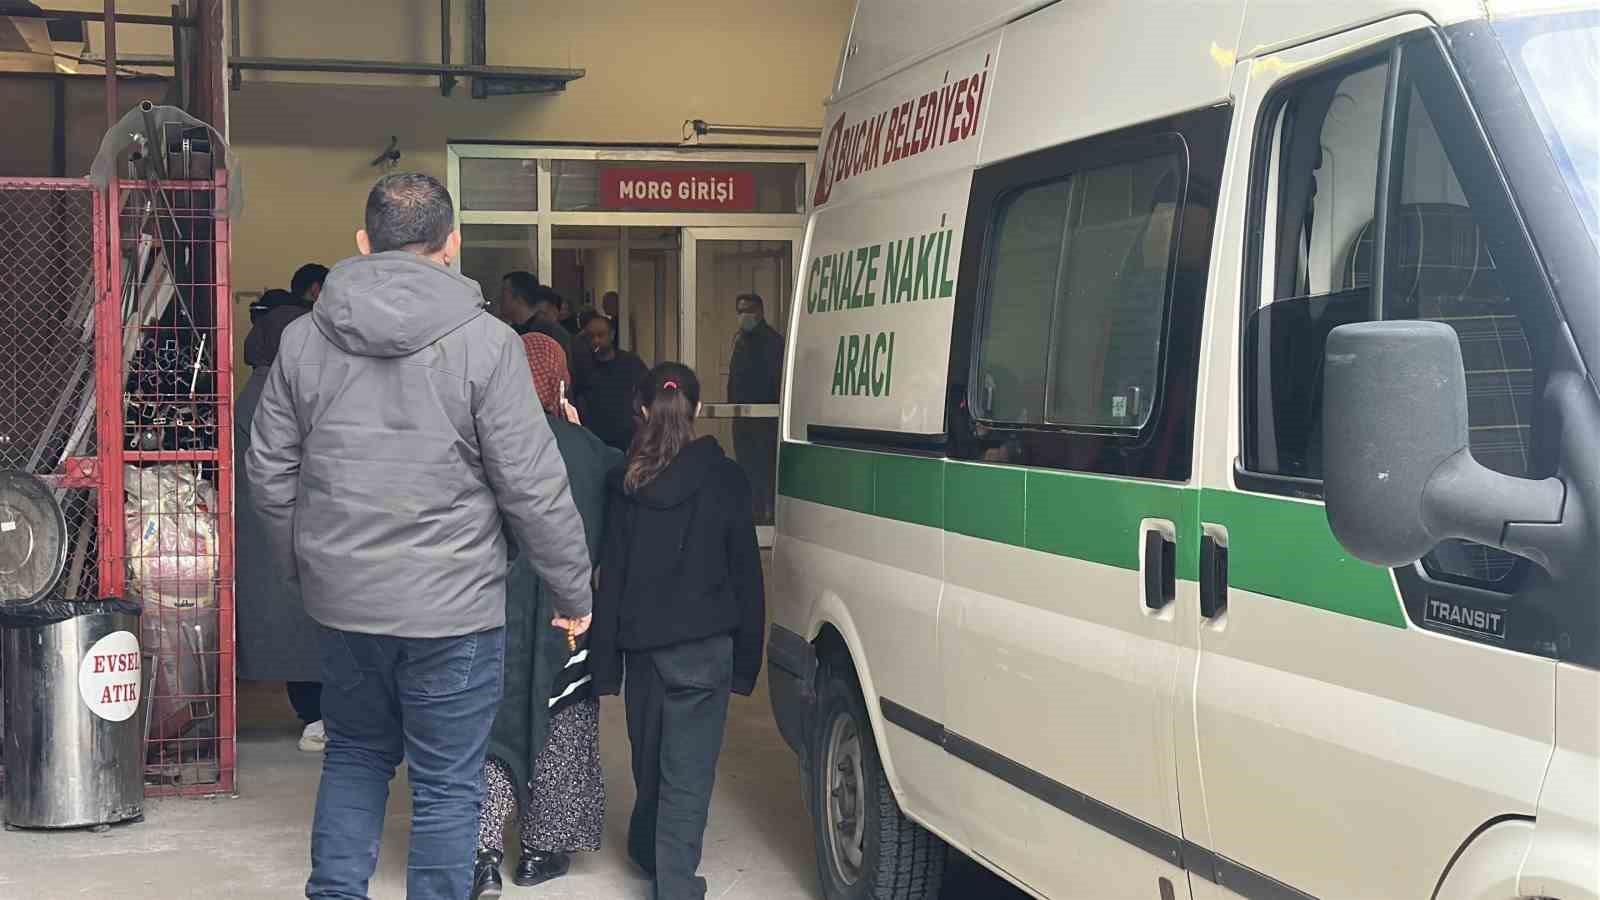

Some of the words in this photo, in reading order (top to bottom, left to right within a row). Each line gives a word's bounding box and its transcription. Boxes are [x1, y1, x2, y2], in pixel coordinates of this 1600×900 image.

[835, 111, 887, 182] BUCAK
[882, 53, 991, 165] BELEDİYESİ
[619, 180, 672, 199] MORG
[678, 176, 734, 203] GİRİŞİ
[807, 245, 881, 315] CENAZE
[882, 212, 954, 305] NAKİL
[831, 331, 895, 397] ARACI
[1430, 599, 1501, 631] TRANSIT
[100, 682, 137, 704] ATIK
